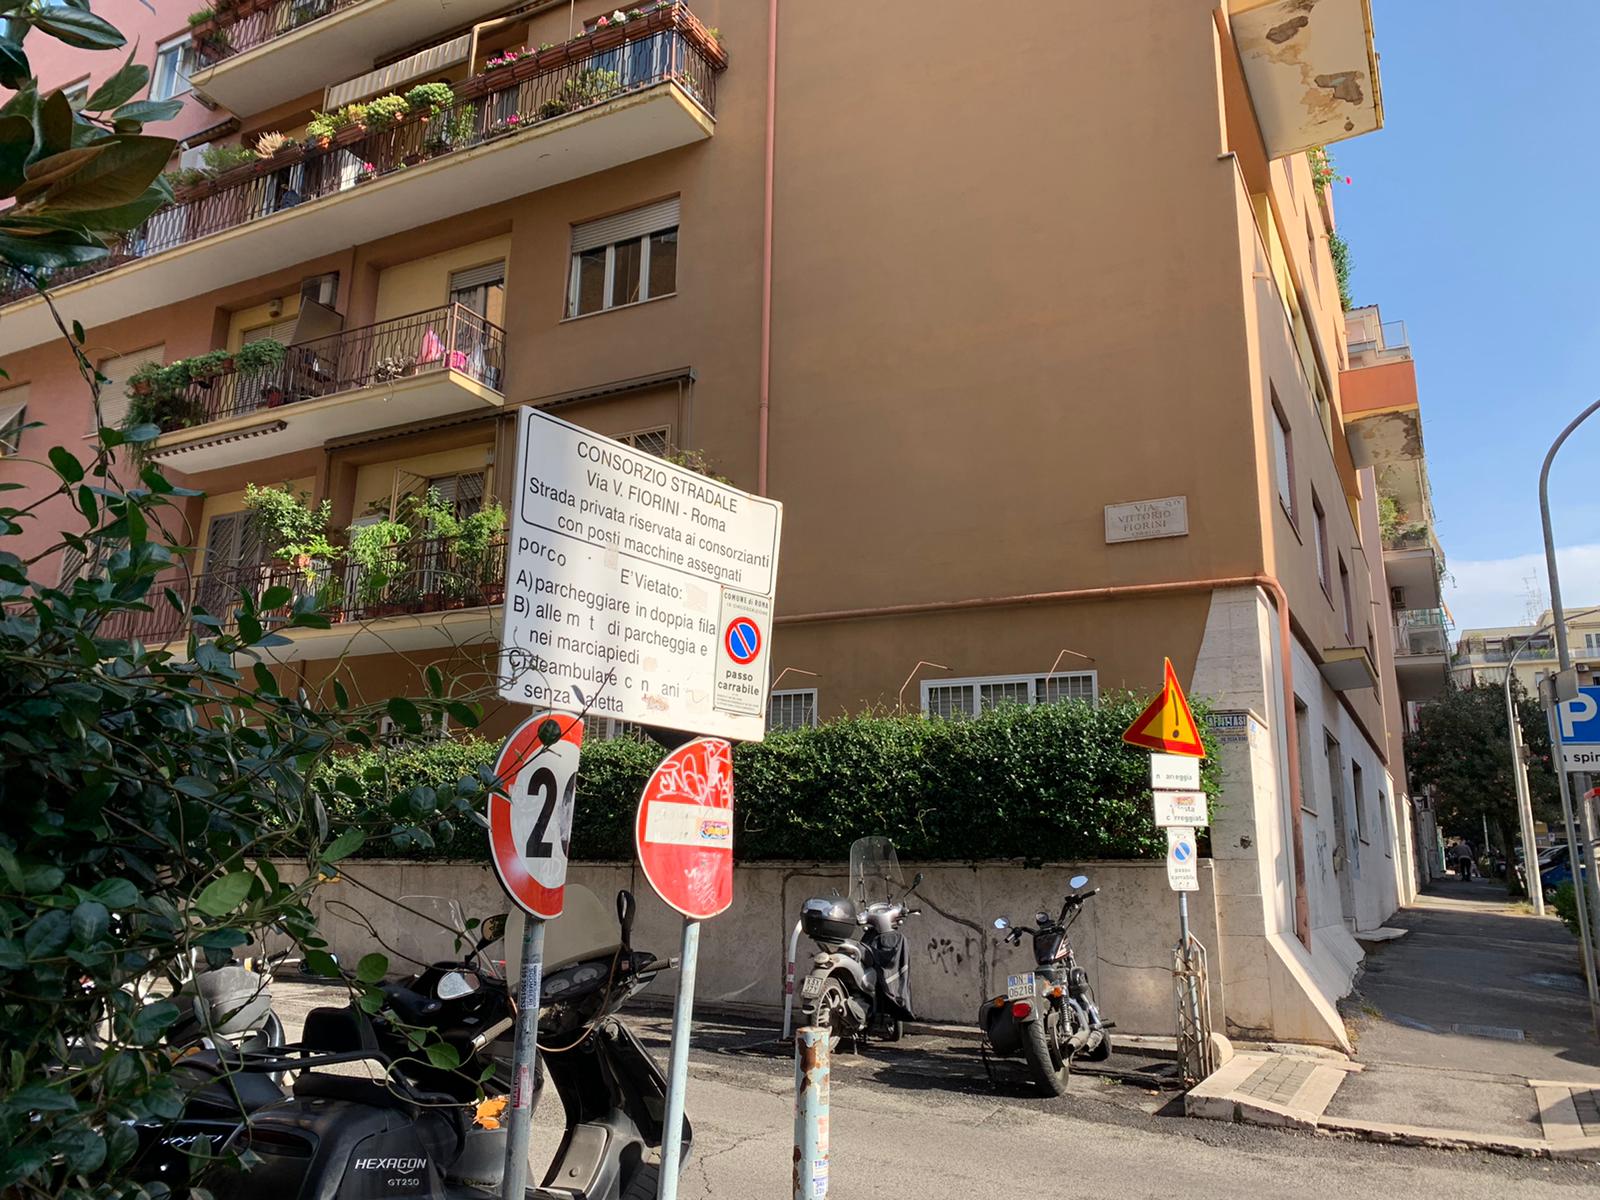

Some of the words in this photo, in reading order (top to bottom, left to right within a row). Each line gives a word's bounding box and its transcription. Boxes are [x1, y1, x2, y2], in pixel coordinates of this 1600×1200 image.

[577, 441, 667, 487] CONSORZIO
[671, 476, 738, 514] STRADALE
[587, 469, 608, 492] Via
[613, 479, 623, 498] V.
[628, 485, 680, 516] FIORINI
[691, 507, 726, 532] Roma
[1134, 504, 1155, 512] VIA
[529, 477, 576, 508] Strada
[580, 498, 625, 526] privata
[629, 514, 682, 542] riservata
[685, 532, 696, 546] ai
[699, 538, 770, 568] consorzianti
[1117, 510, 1171, 523] VITTORIO
[1123, 520, 1166, 533] FIORINI
[518, 537, 567, 567] porco
[558, 515, 583, 534] con
[588, 526, 620, 546] posti
[624, 537, 684, 566] macchine
[687, 556, 742, 582] assegnati
[513, 595, 530, 618] B)
[536, 603, 562, 622] alle
[608, 620, 621, 636] di
[624, 626, 696, 656] parcheggia
[700, 645, 708, 656] e
[635, 601, 647, 618] in
[650, 607, 694, 630] doppia
[698, 617, 716, 635] fila
[529, 629, 552, 646] nei
[557, 636, 640, 665] marciapiedi
[661, 682, 680, 698] ani
[717, 681, 760, 696] carrabile
[725, 670, 753, 682] passo
[524, 683, 571, 704] senza
[583, 692, 624, 713] aletta
[1558, 693, 1598, 737] P
[355, 1158, 427, 1170] HEXAGON
[387, 1178, 420, 1187] GT250
